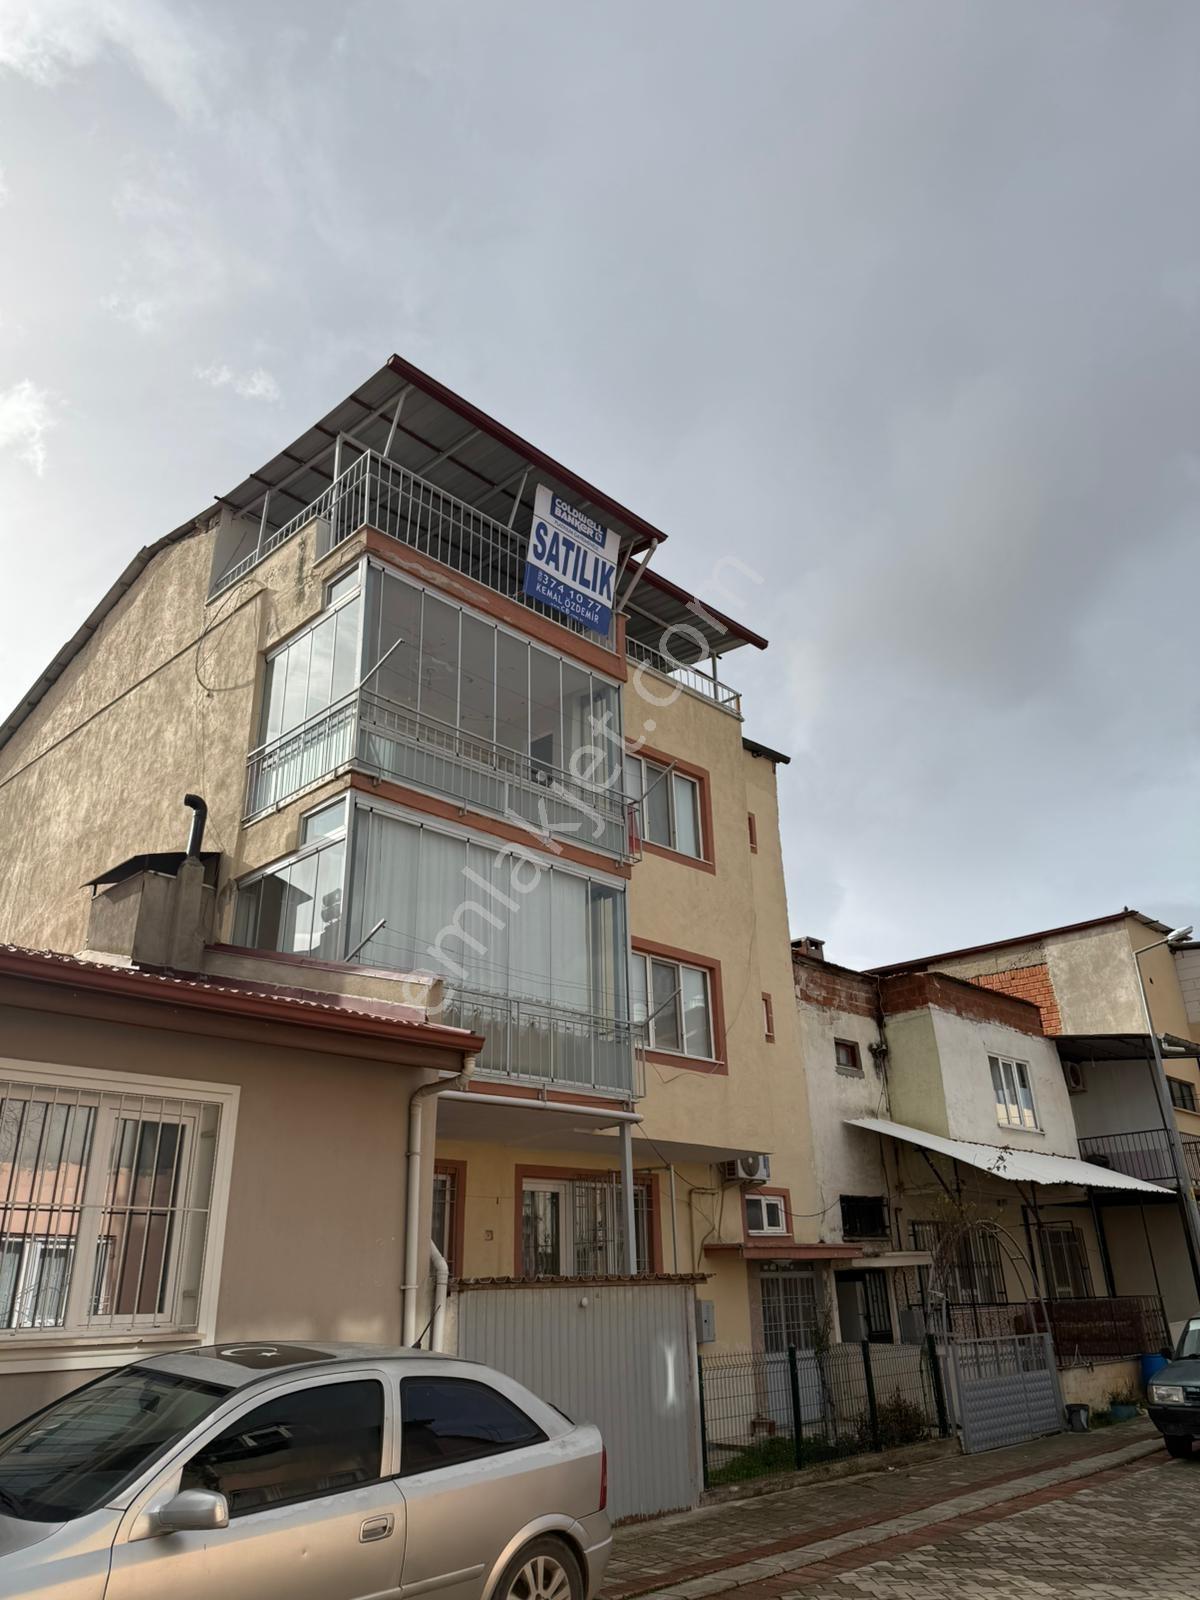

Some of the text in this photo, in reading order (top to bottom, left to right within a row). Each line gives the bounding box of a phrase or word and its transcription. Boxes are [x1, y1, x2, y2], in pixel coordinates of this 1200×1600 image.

[554, 507, 593, 537] BANKER
[533, 521, 615, 602] SATILIK
[535, 583, 562, 604] KEMAL
[542, 575, 564, 593] 374
[569, 591, 583, 603] 10
[588, 599, 602, 613] 77
